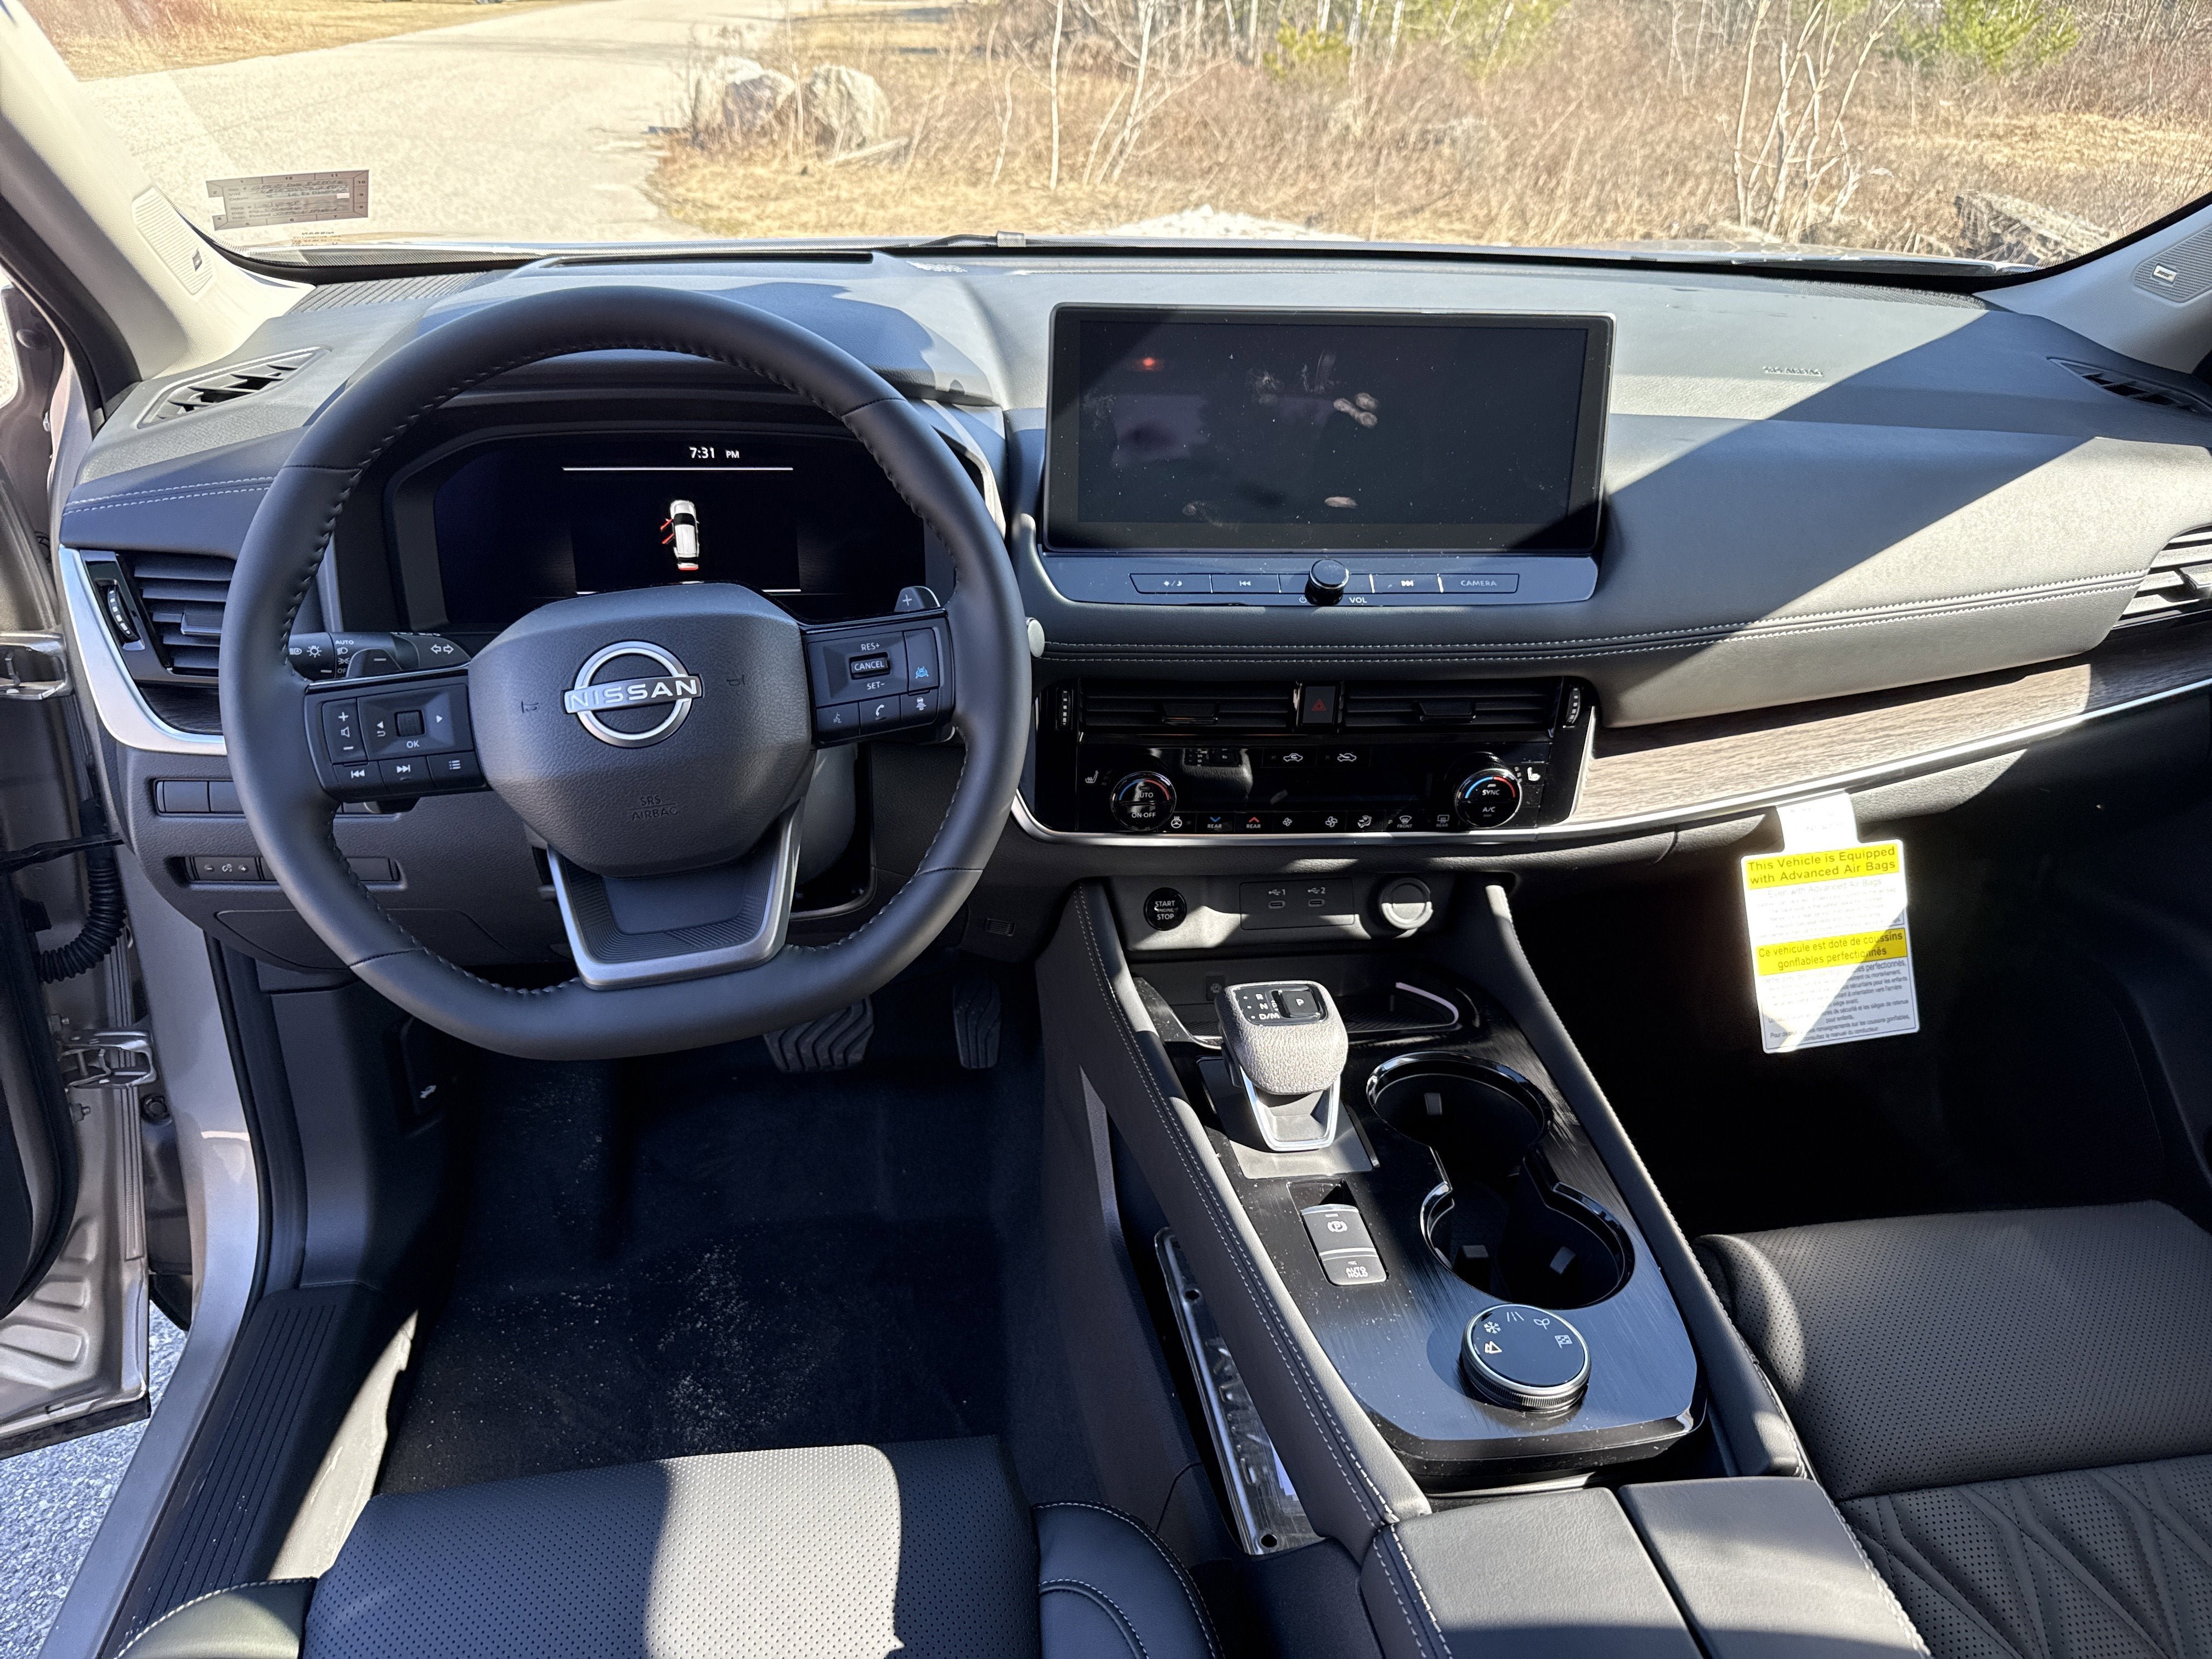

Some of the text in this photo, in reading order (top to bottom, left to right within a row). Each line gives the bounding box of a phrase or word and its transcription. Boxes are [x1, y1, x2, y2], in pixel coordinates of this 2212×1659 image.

[689, 447, 740, 459] 7:31 PM
[861, 642, 880, 651] RES+
[854, 660, 884, 671] CANCEL
[867, 681, 885, 690] SET-
[569, 680, 697, 709] NISSAN
[406, 740, 420, 748] OK
[640, 795, 661, 806] SRS
[631, 805, 679, 821] AIRBAG
[1748, 847, 1895, 871] This Vehicle is Equipped
[1750, 861, 1895, 884] with Advanced Air Bags
[1759, 948, 1770, 957] Ce
[1813, 941, 1826, 950] est
[1829, 938, 1848, 949] doté
[1850, 936, 1861, 945] de
[1864, 932, 1903, 944] coussins
[1778, 946, 1887, 970] gonflables perfectionnés
